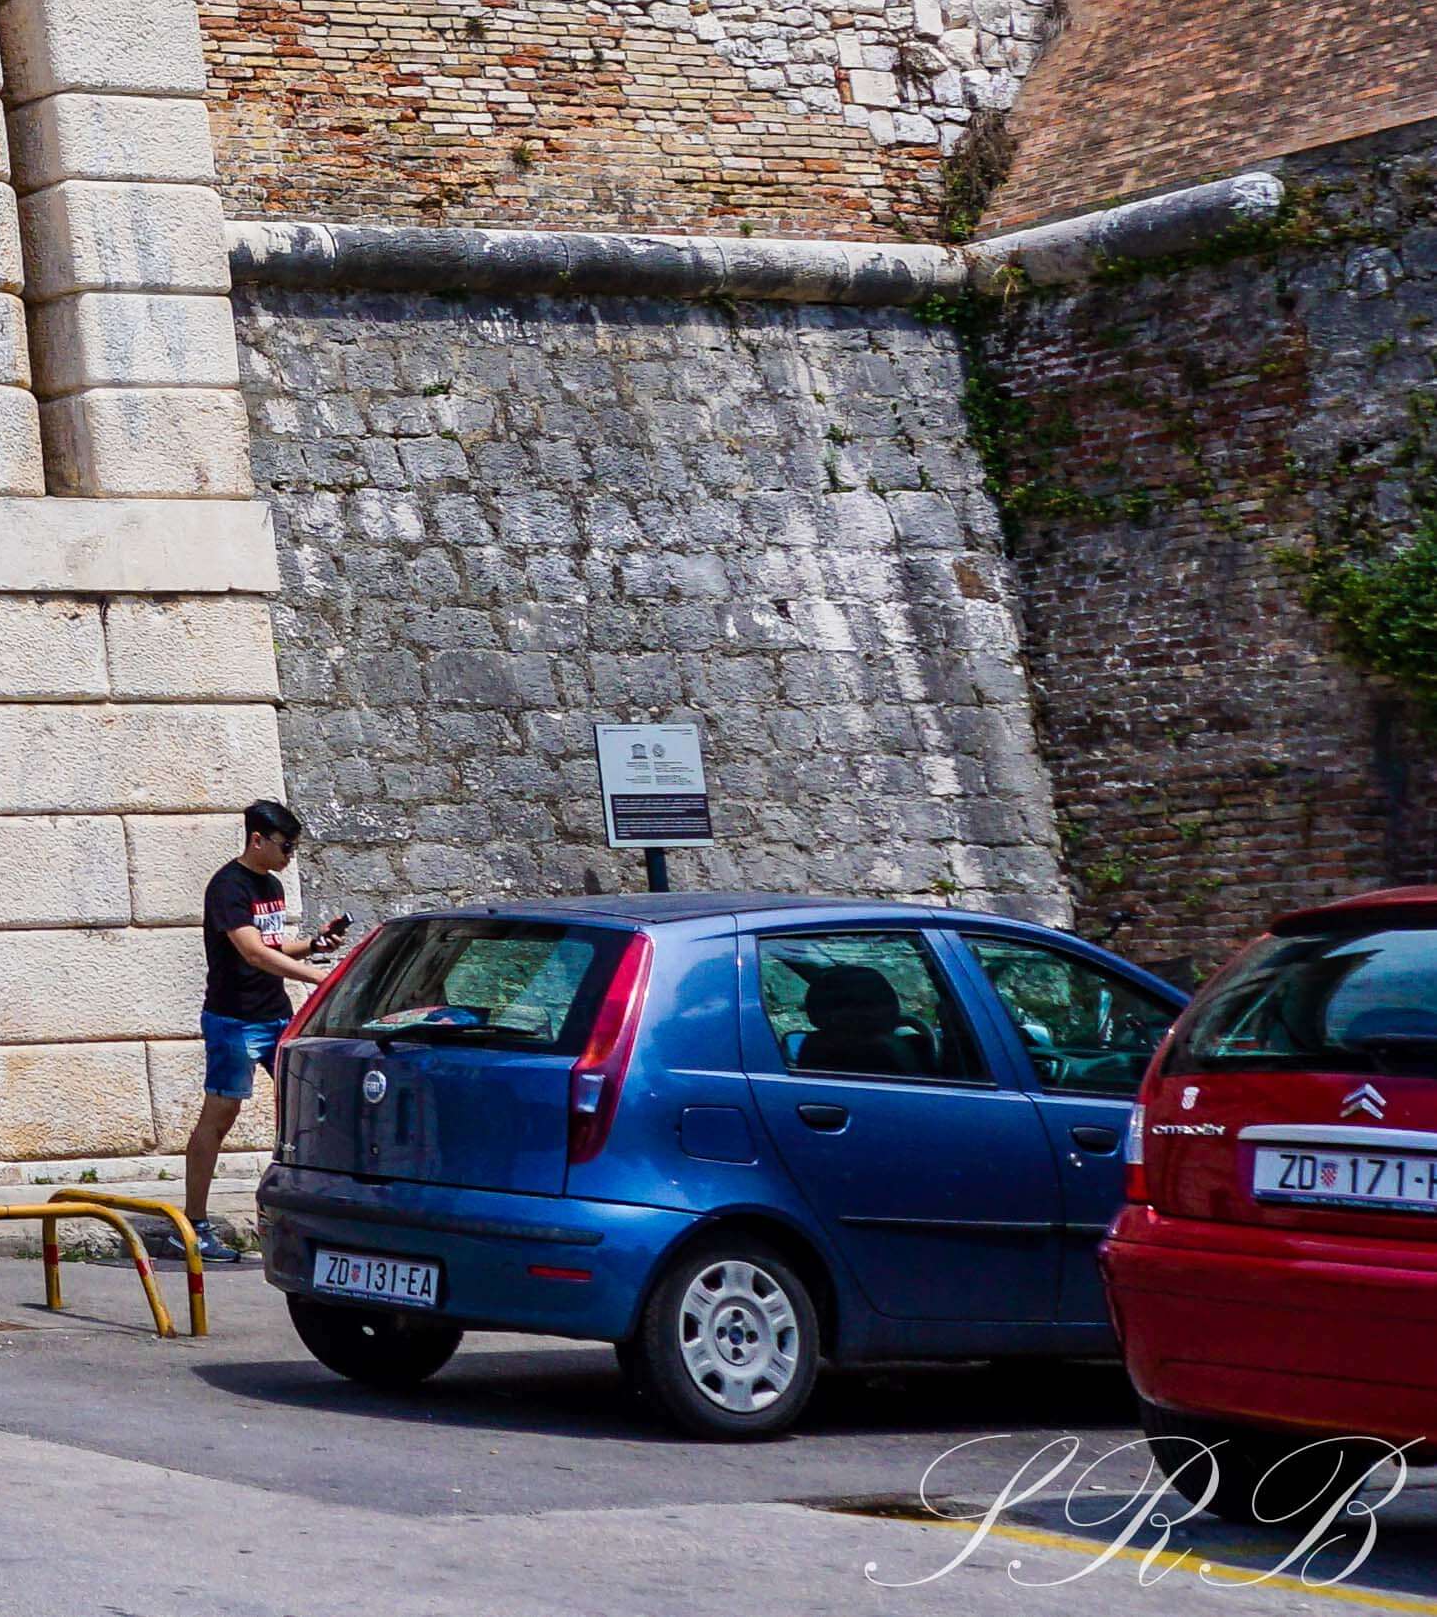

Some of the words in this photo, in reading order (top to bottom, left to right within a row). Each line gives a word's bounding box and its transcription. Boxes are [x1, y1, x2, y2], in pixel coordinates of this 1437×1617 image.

[1278, 1154, 1317, 1190] ZD
[326, 1256, 350, 1286] ZD
[365, 1261, 432, 1298] 131-EA
